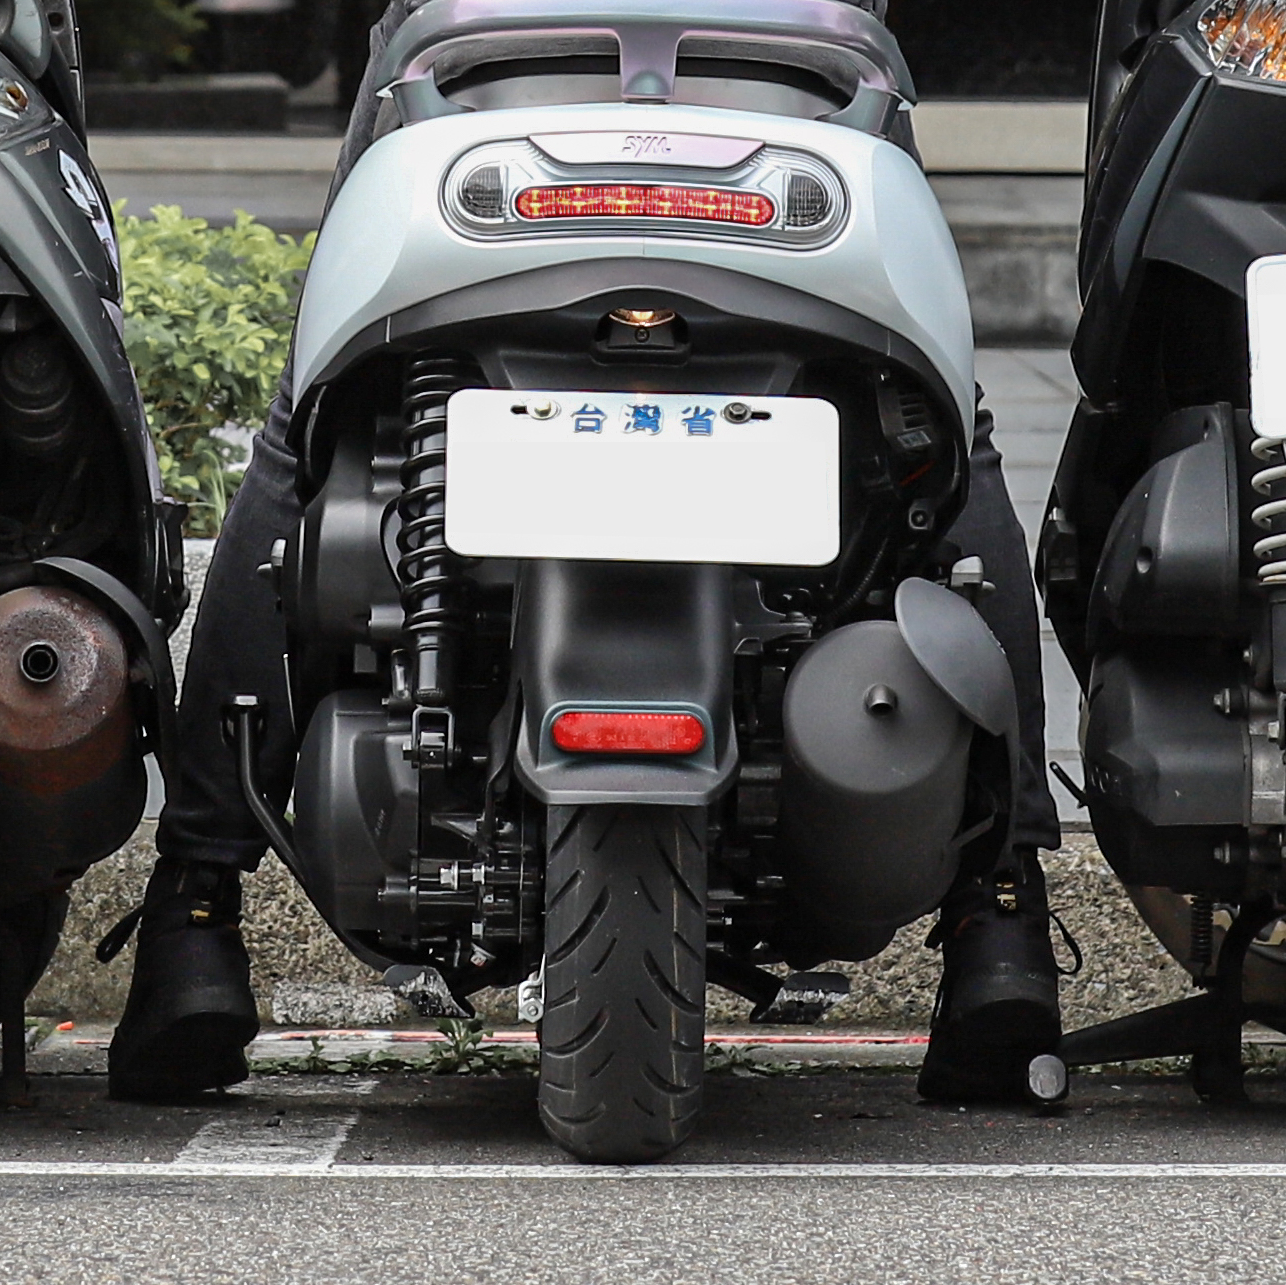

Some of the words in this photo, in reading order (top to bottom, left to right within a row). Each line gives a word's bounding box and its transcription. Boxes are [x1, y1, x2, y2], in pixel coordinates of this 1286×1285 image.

[622, 135, 671, 158] SYM
[571, 403, 716, 436] 台灣省
